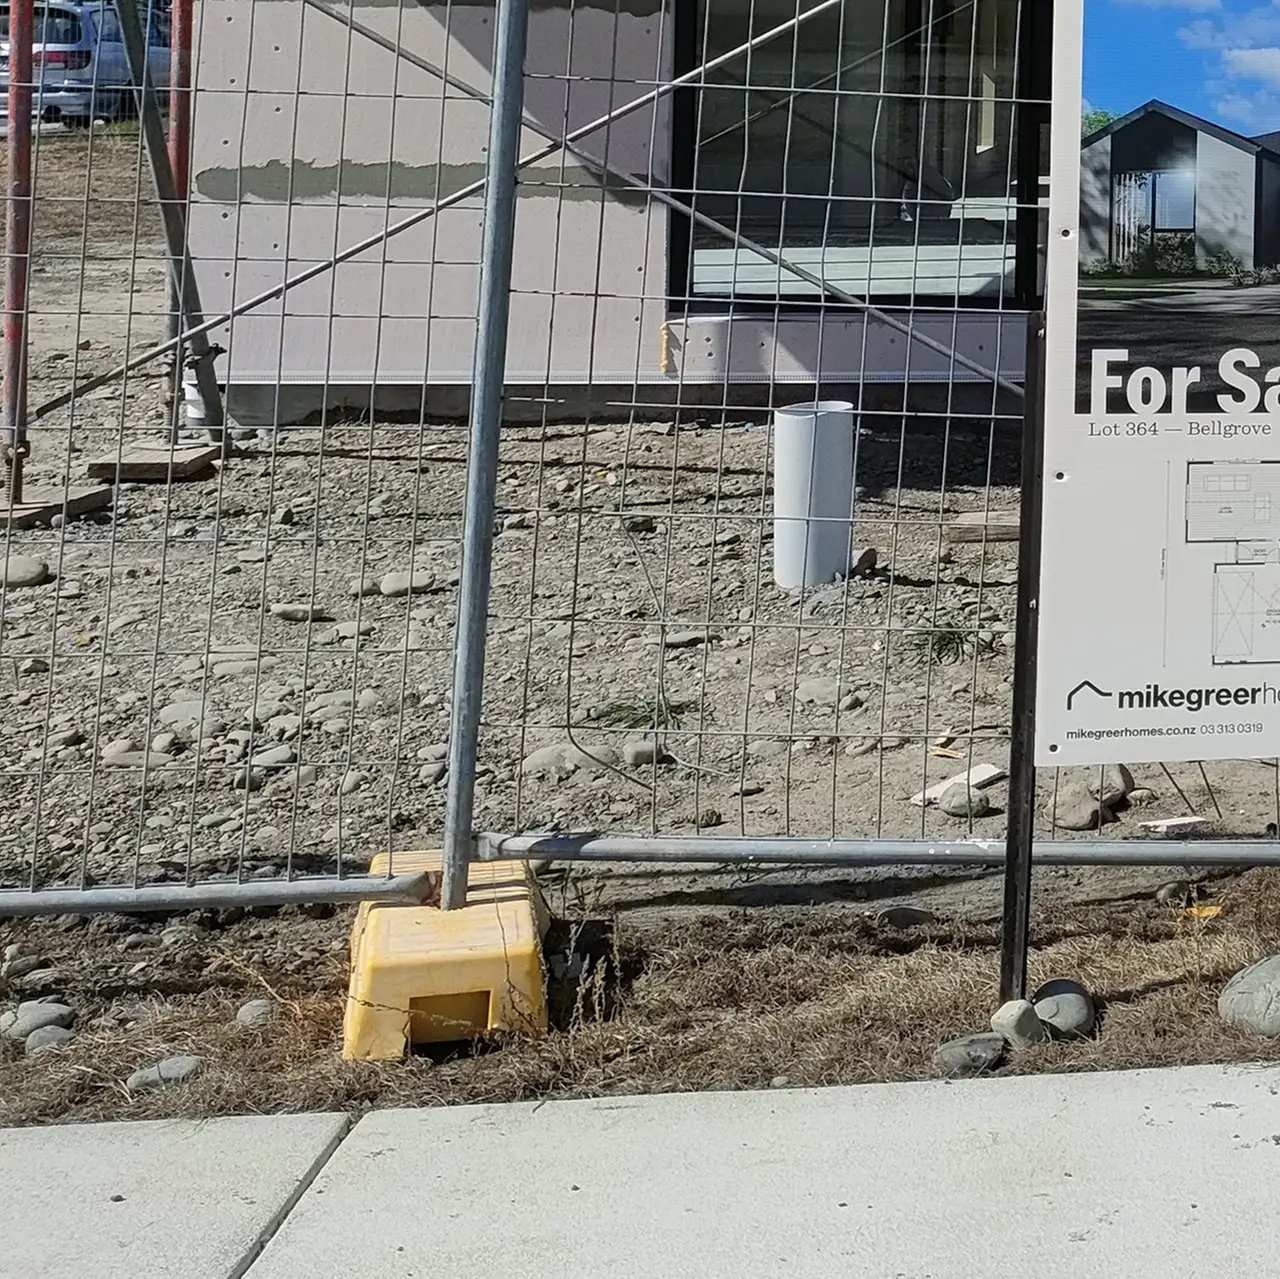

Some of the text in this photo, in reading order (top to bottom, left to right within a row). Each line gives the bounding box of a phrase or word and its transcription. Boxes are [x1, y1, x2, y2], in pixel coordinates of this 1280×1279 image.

[1091, 348, 1200, 415] For
[1088, 422, 1121, 436] Lot
[1125, 422, 1159, 436] 364
[1187, 420, 1271, 438] Bellgrove
[1066, 726, 1196, 740] mikegreerhomes.co.nz
[1237, 723, 1263, 734] 0319
